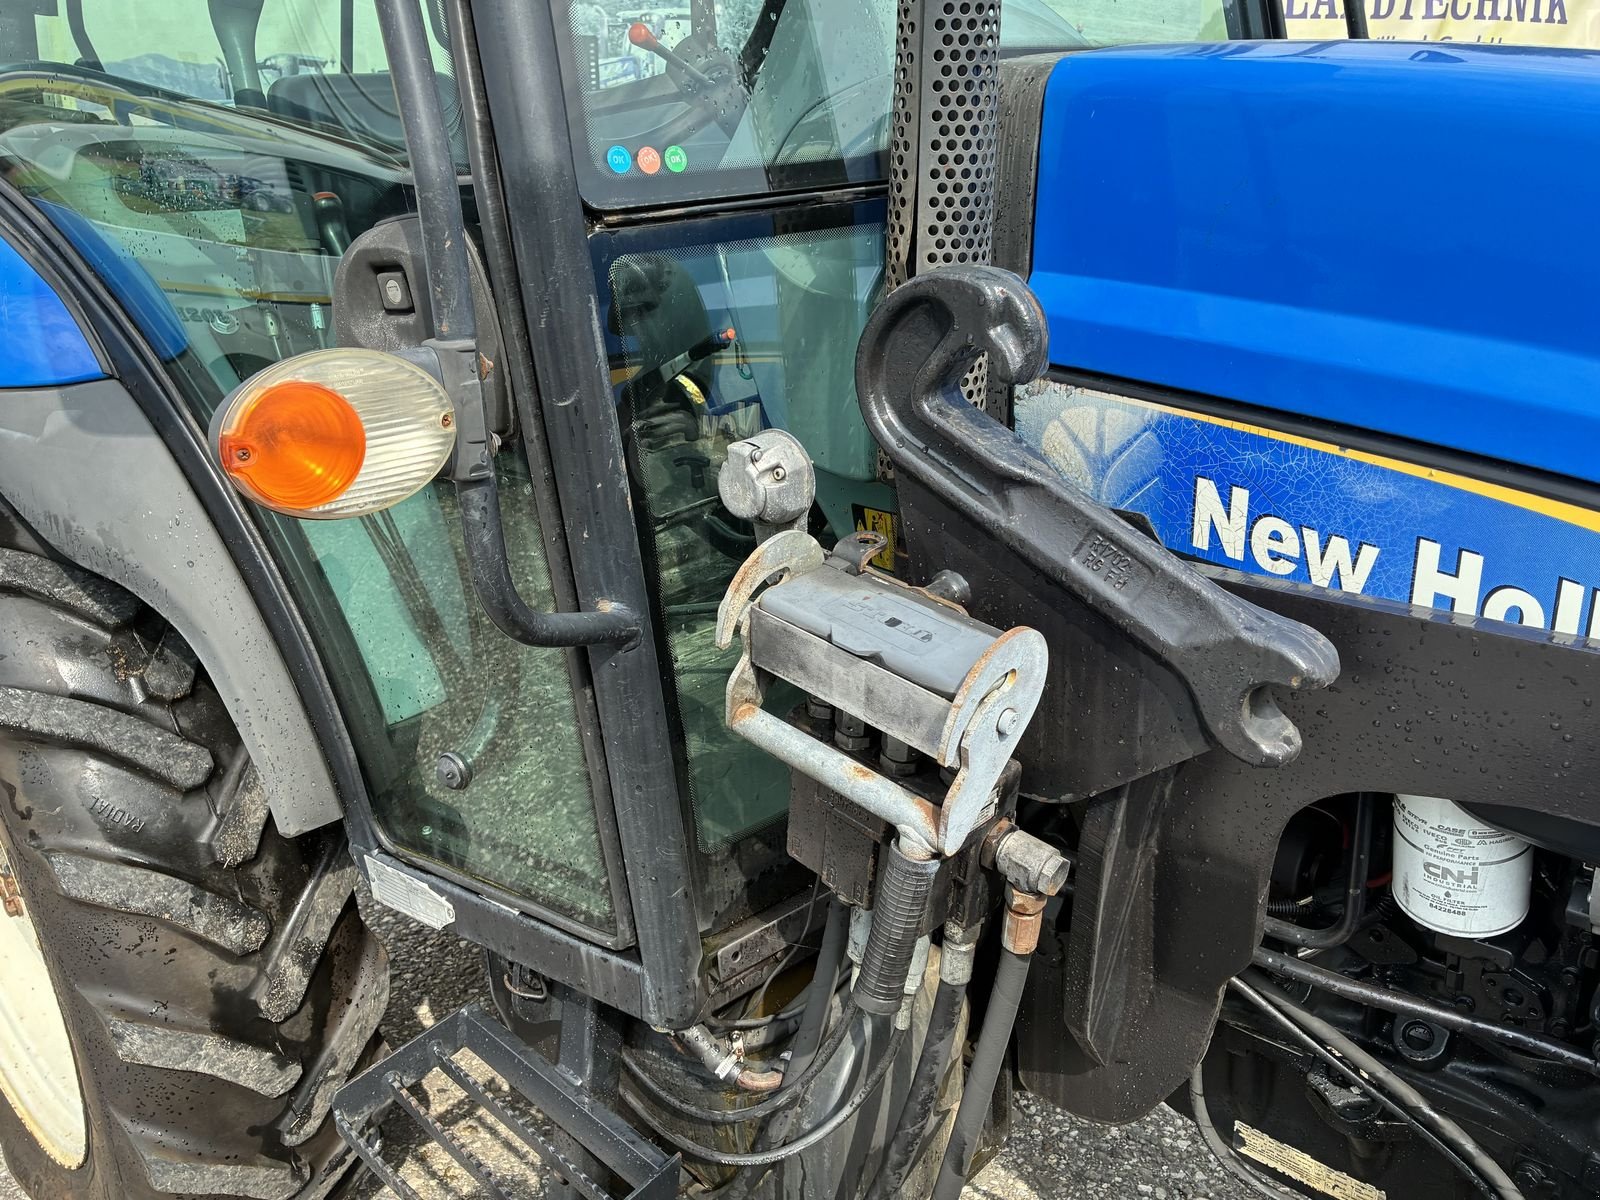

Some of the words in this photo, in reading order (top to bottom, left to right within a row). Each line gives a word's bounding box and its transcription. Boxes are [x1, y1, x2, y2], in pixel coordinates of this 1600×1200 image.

[1285, 0, 1568, 24] LADTECHNIK
[613, 155, 624, 164] OK
[670, 155, 681, 163] OK
[1191, 475, 1380, 595] New
[1410, 536, 1600, 637] Hol
[90, 793, 145, 833] RADIAL
[1423, 829, 1448, 841] IVECO
[1437, 824, 1466, 835] CASE
[1424, 844, 1456, 859] Genuine
[1433, 854, 1477, 866] PERFORMANCE
[1423, 872, 1478, 890] INDUSTRIAL
[1443, 897, 1466, 905] FILTER
[1428, 902, 1467, 916] 84228488
